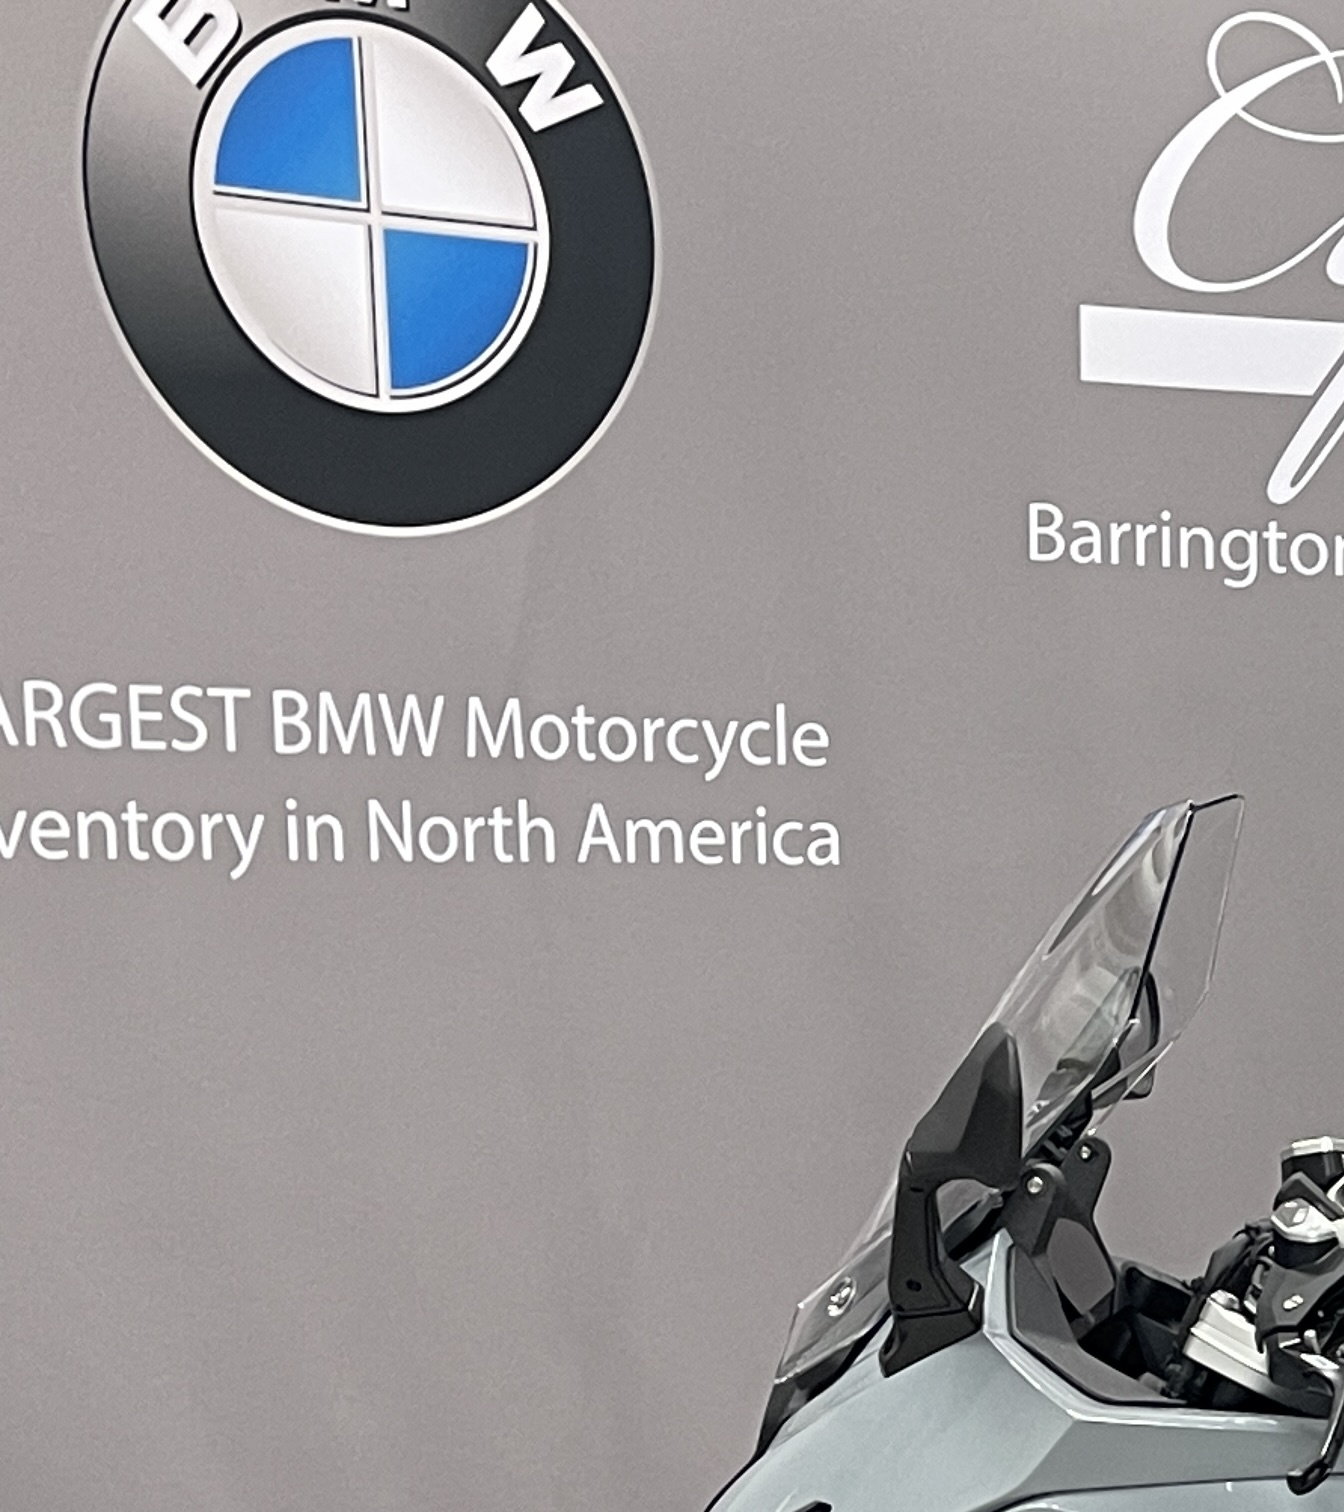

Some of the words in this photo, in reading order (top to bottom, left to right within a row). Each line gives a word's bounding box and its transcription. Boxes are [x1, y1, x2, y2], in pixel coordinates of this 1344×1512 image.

[271, 688, 446, 758] BMW
[465, 695, 830, 783] Motorcycle
[284, 796, 346, 863] in
[366, 797, 557, 864] North
[576, 801, 841, 867] America
